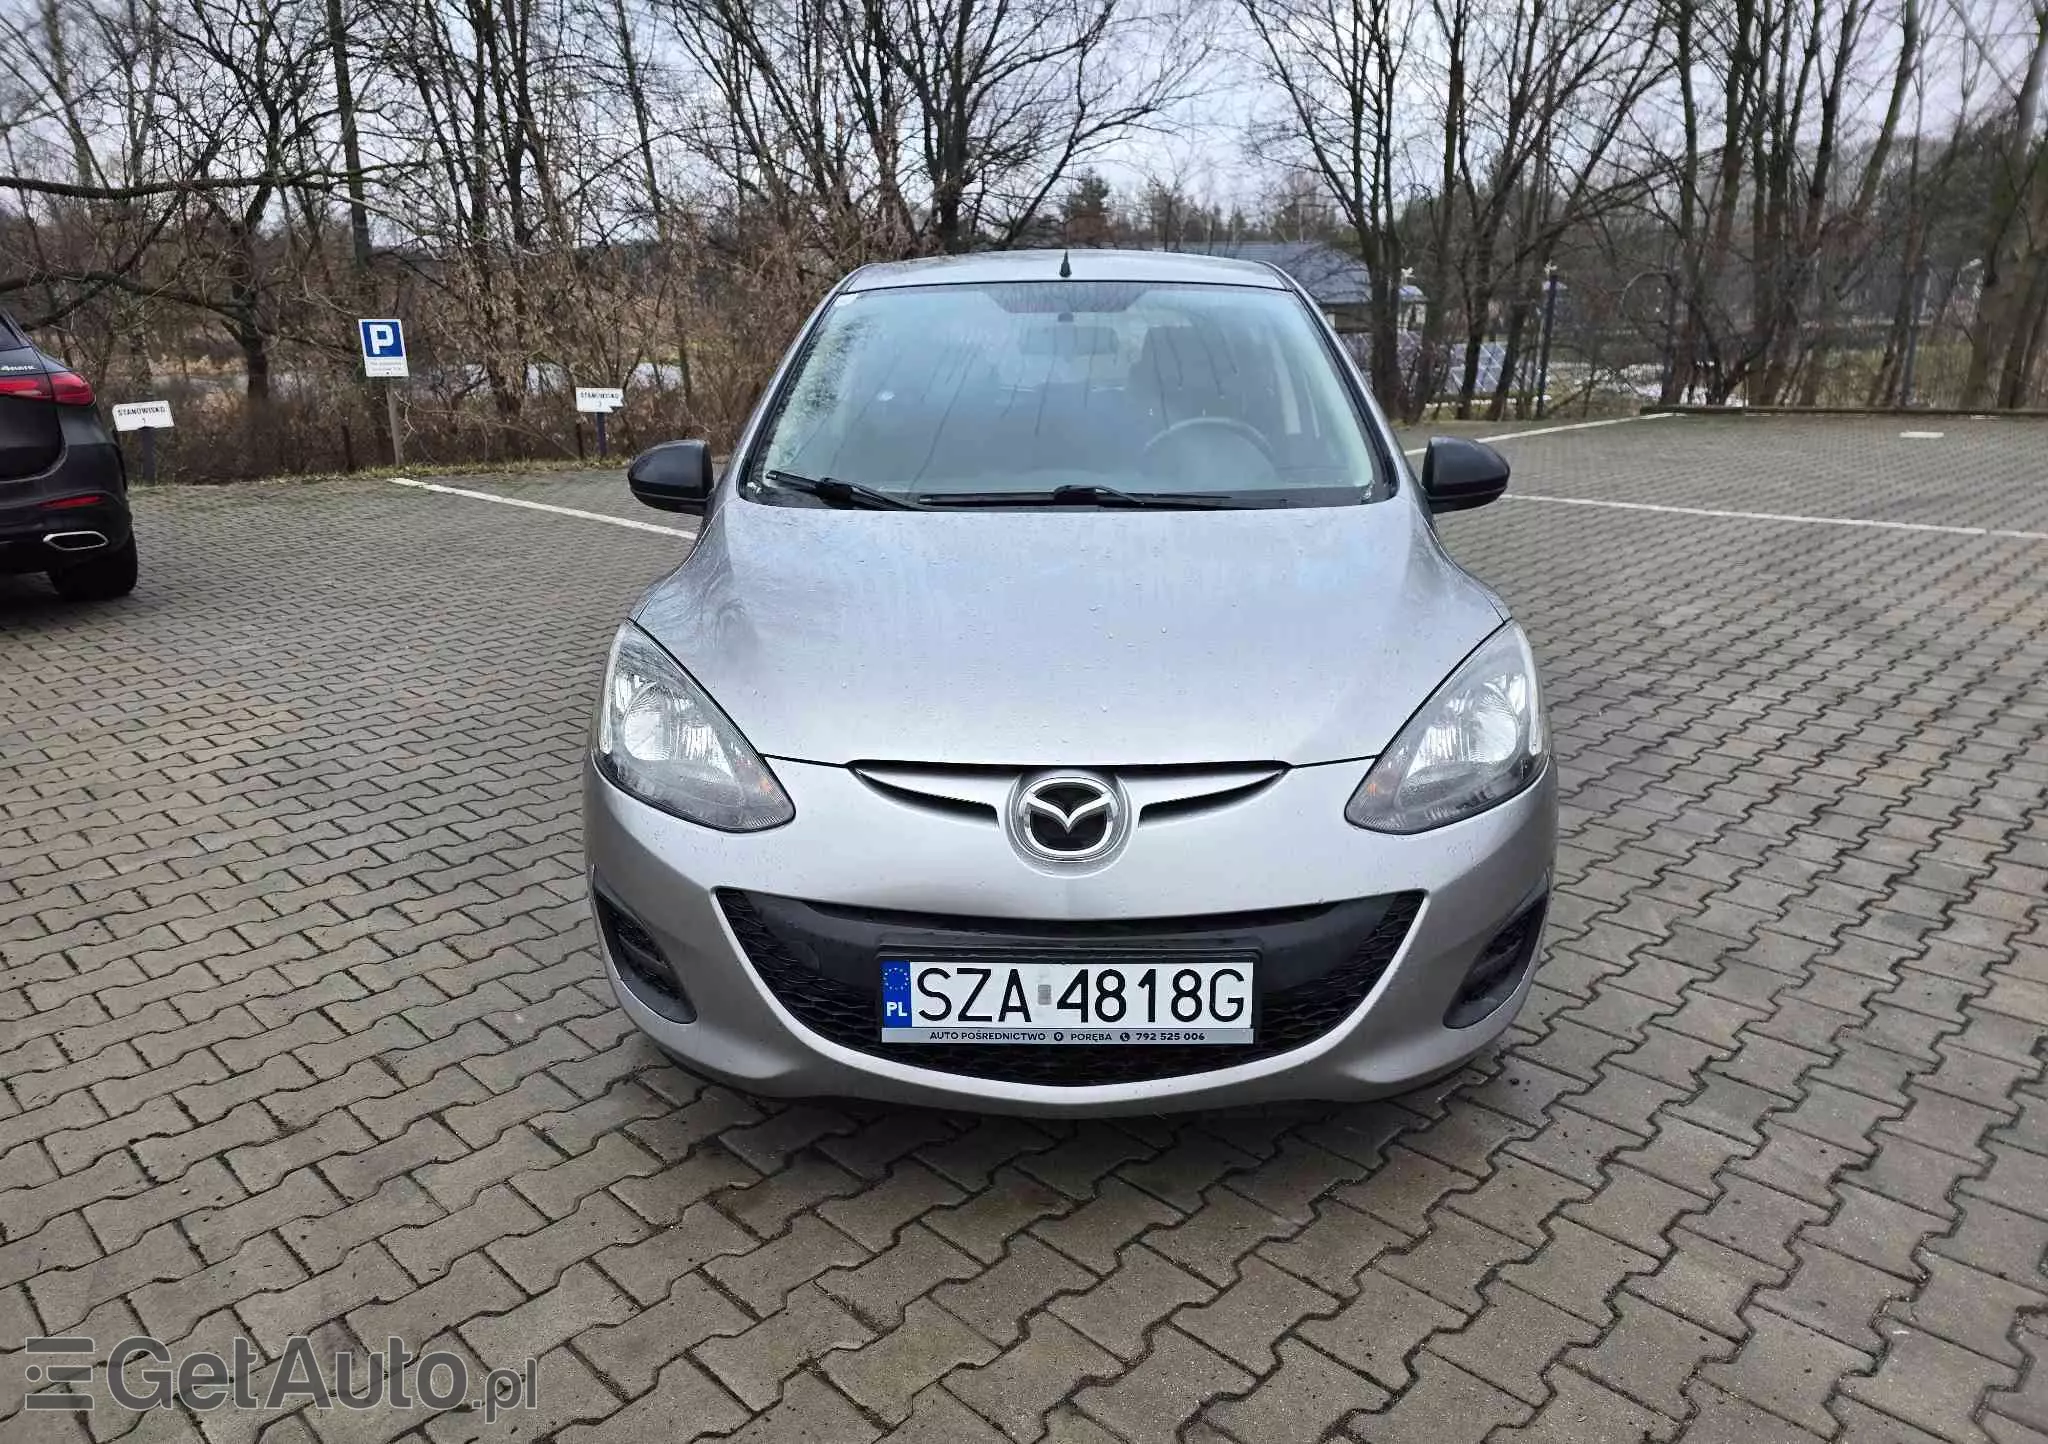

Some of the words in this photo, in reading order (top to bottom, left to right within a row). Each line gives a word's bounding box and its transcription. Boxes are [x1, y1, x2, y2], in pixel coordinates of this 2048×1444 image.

[369, 324, 394, 355] P
[916, 967, 1032, 1023] SZA
[1056, 968, 1245, 1024] 4818G
[886, 1002, 908, 1018] PL
[929, 1031, 959, 1040] AUTO
[961, 1029, 1046, 1041] POŚREDNICTWO
[1070, 1032, 1113, 1042] PORĘBA
[1136, 1032, 1157, 1041] 792
[1160, 1032, 1181, 1041] 525
[1183, 1032, 1206, 1041] 006
